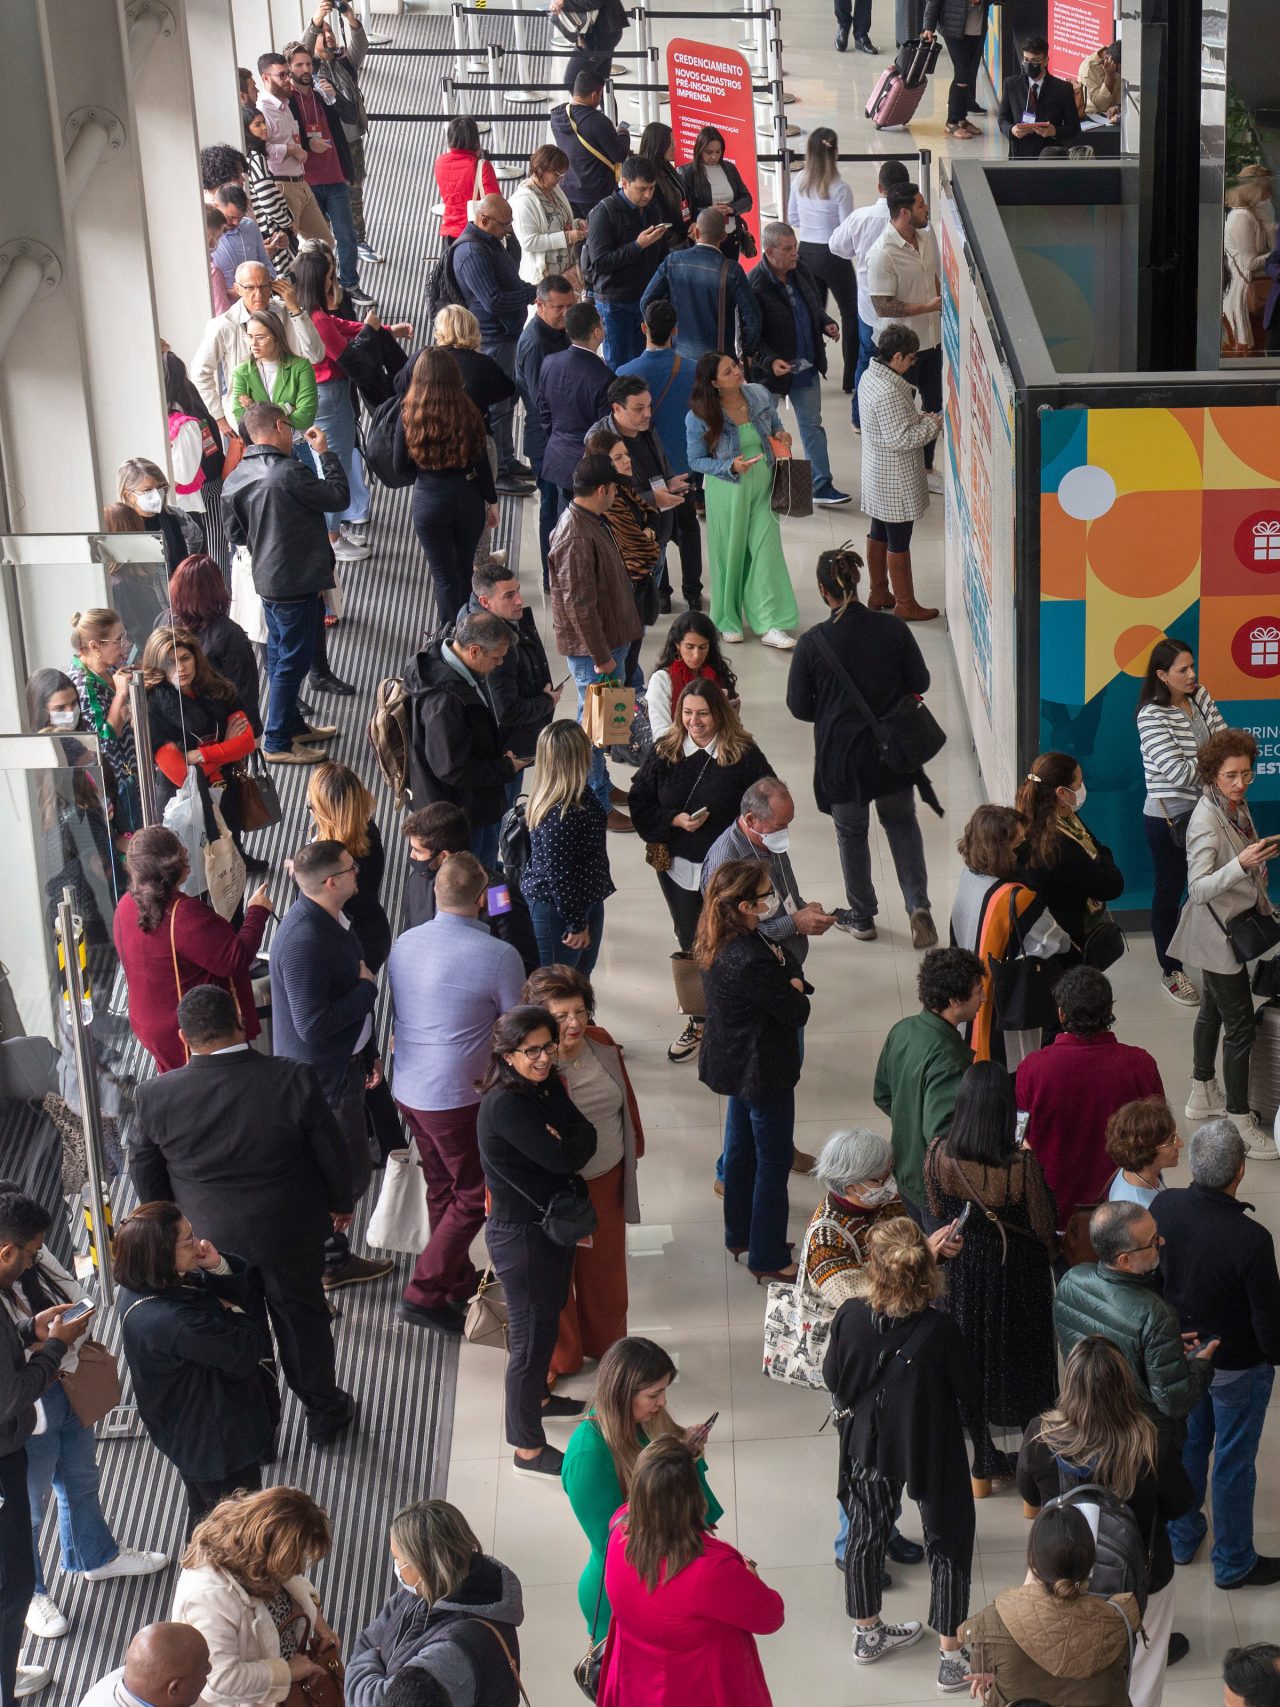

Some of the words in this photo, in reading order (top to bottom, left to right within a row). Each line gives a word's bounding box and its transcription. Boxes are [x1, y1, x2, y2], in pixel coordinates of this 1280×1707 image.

[674, 53, 743, 76] CREDENCIAMENTO
[675, 68, 700, 81] NOVOS
[701, 74, 742, 90] CADASTROS
[676, 78, 725, 96] PRÉ-INSCRITOS
[677, 88, 711, 103] IMPRENSA
